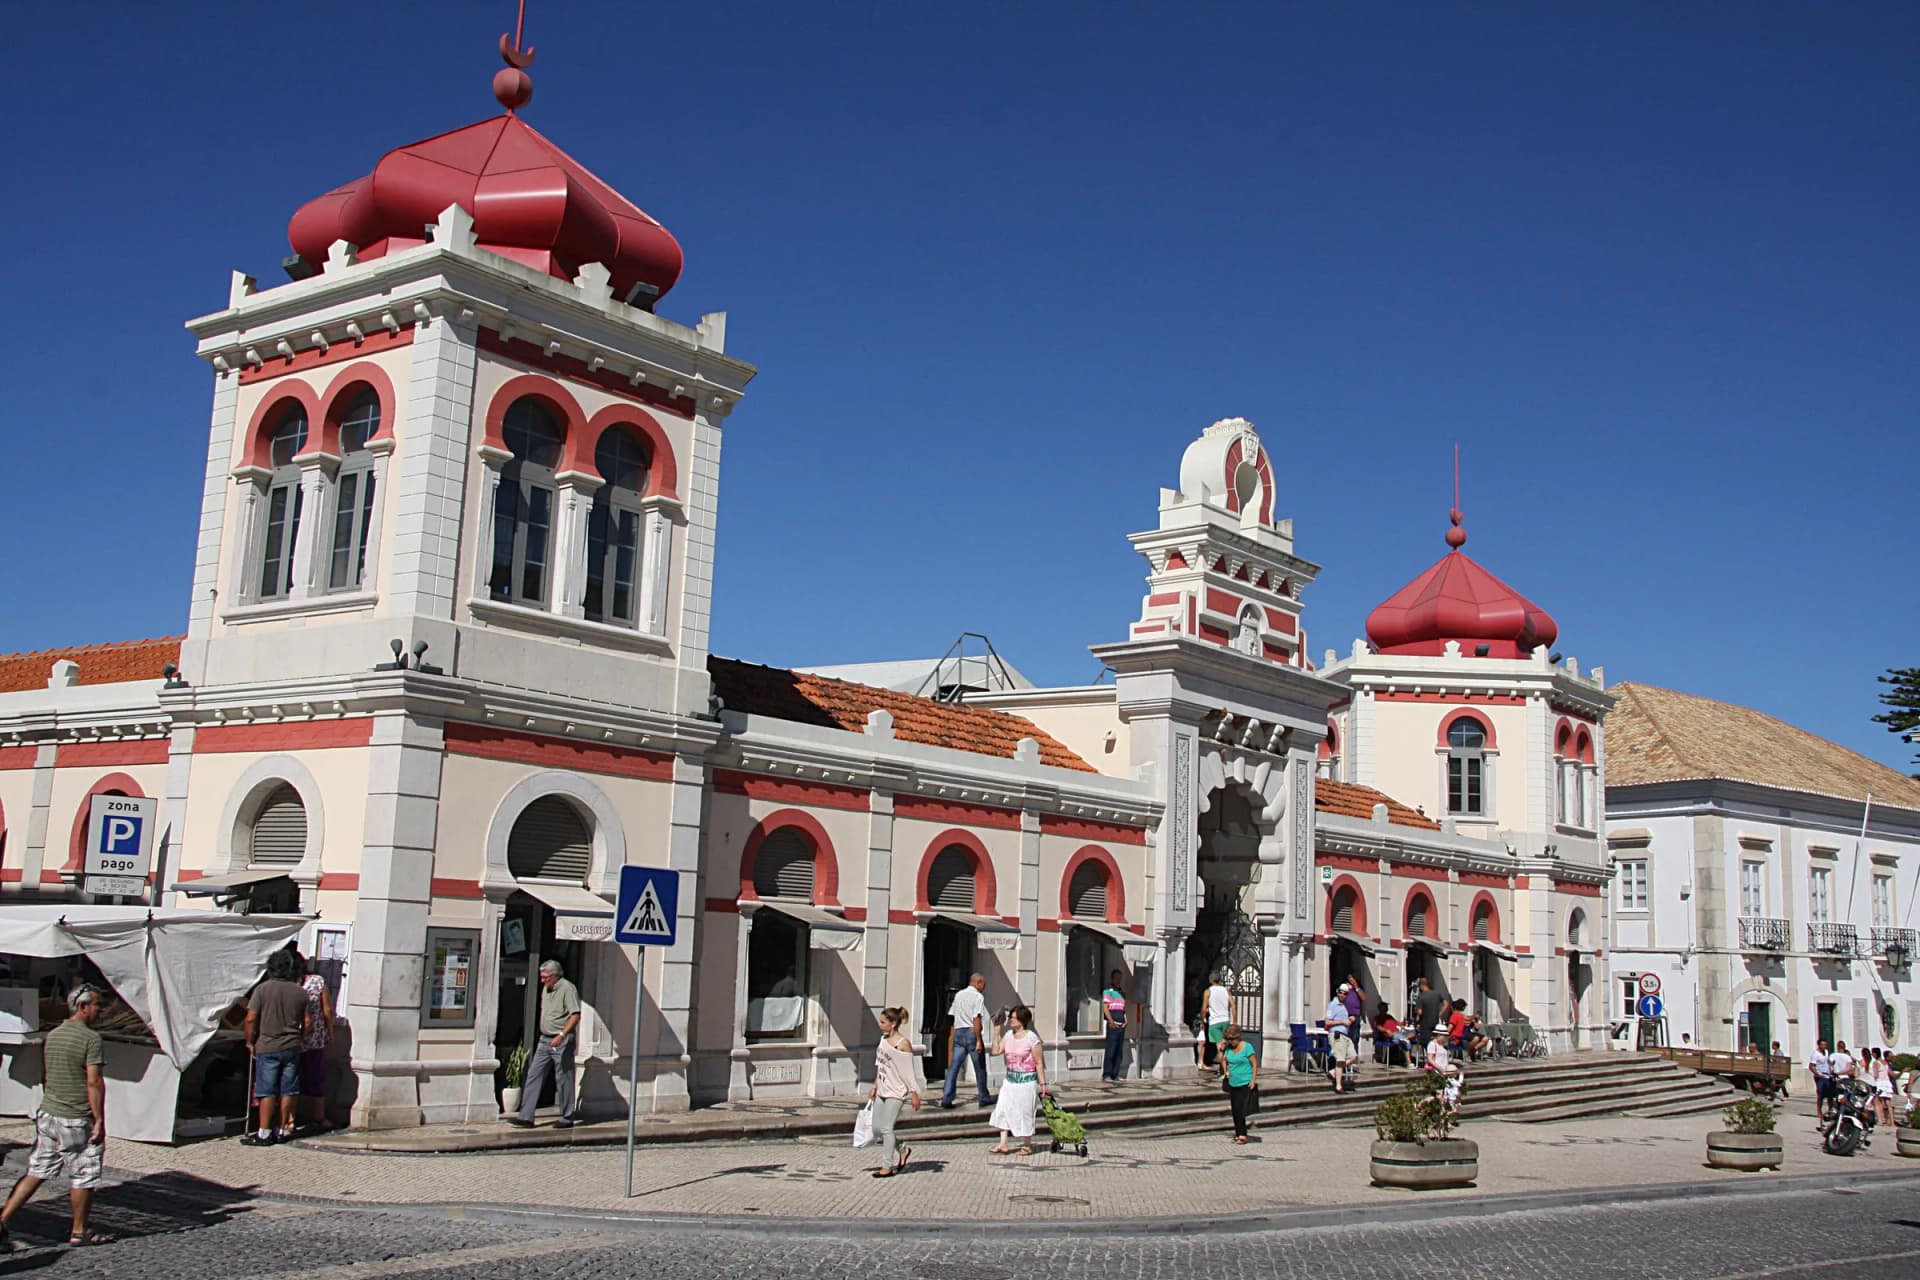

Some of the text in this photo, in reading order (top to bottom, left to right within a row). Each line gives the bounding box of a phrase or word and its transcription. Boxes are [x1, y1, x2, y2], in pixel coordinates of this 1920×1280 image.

[108, 801, 140, 812] zona
[106, 818, 135, 853] P
[101, 859, 134, 871] pago
